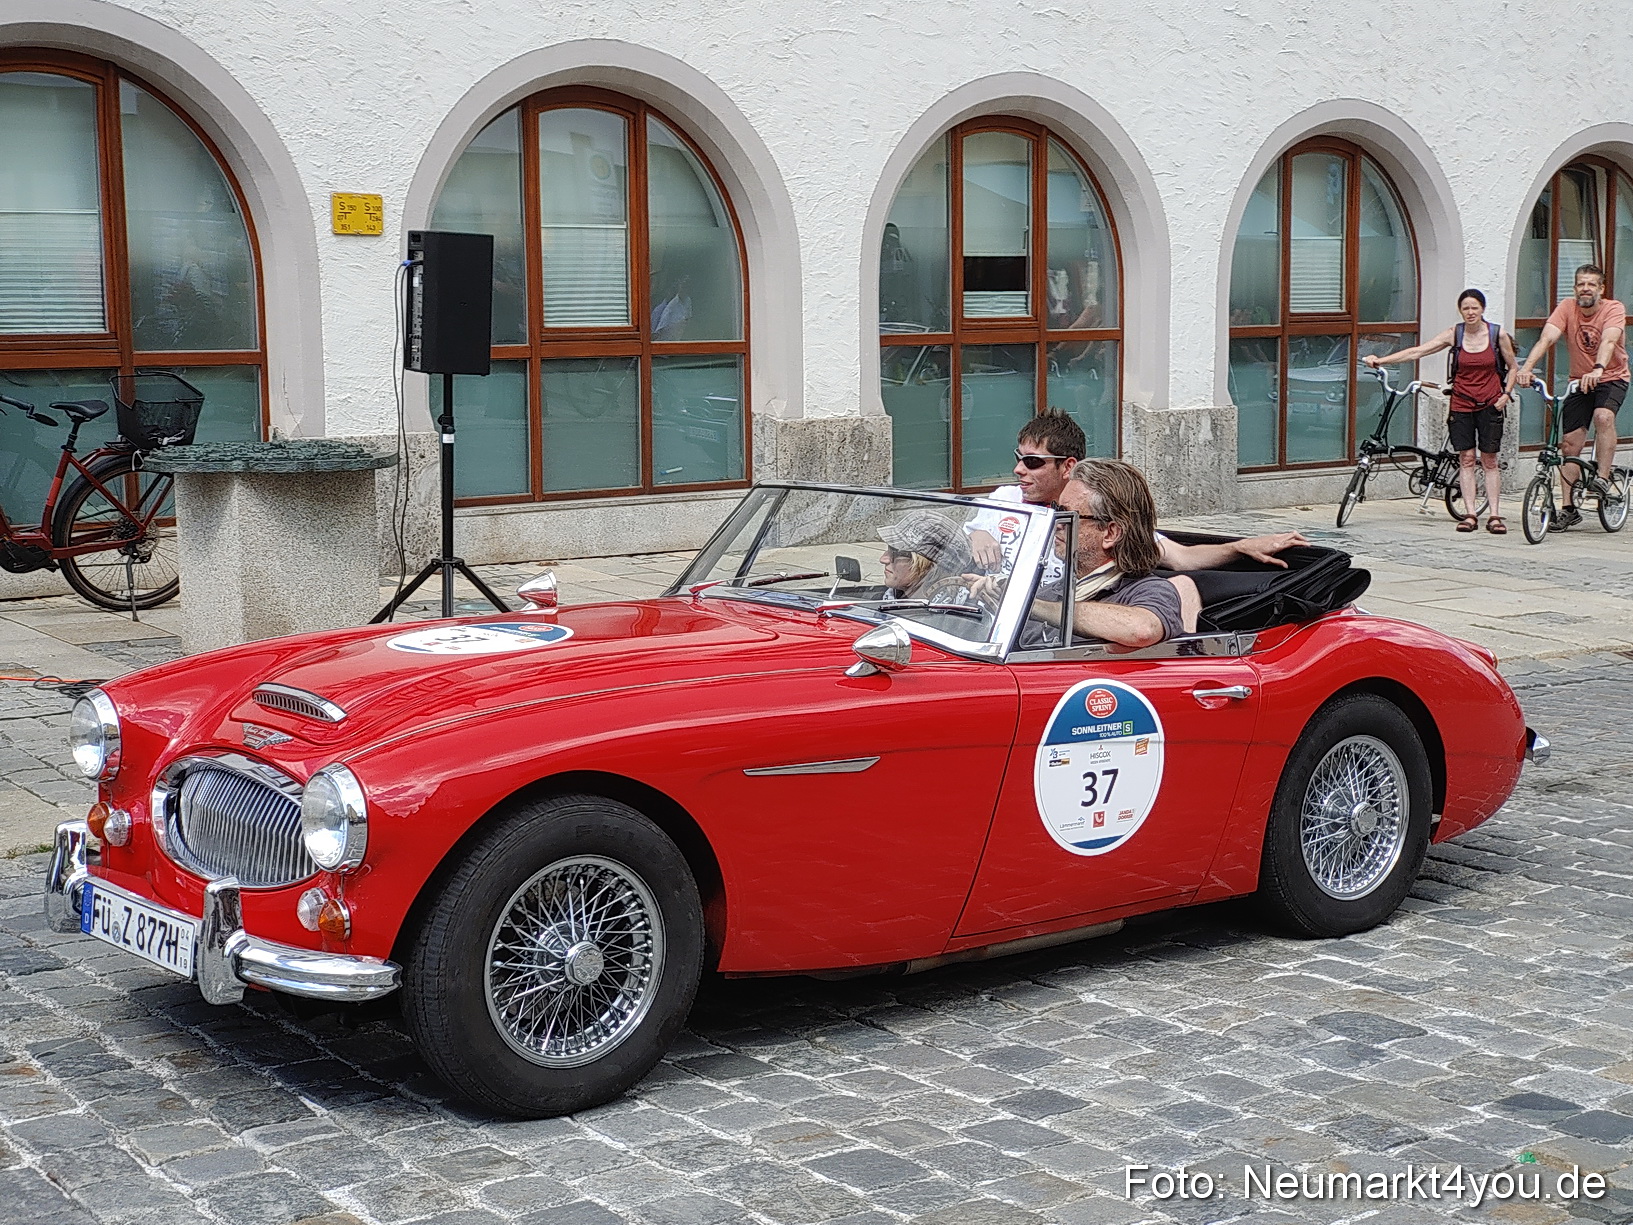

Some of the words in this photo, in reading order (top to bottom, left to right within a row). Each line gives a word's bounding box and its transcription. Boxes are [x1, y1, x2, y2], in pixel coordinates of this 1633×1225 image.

[339, 201, 346, 210] S
[364, 202, 371, 211] S
[1090, 697, 1113, 705] CLASSIC
[1092, 704, 1112, 712] SPRINT
[1072, 722, 1122, 735] SONNLEITNER
[1090, 751, 1111, 760] HISCOX
[1081, 768, 1118, 807] 37
[84, 912, 90, 924] D
[92, 893, 111, 936] FÜ
[122, 905, 133, 946] Z
[136, 913, 180, 965] 877H
